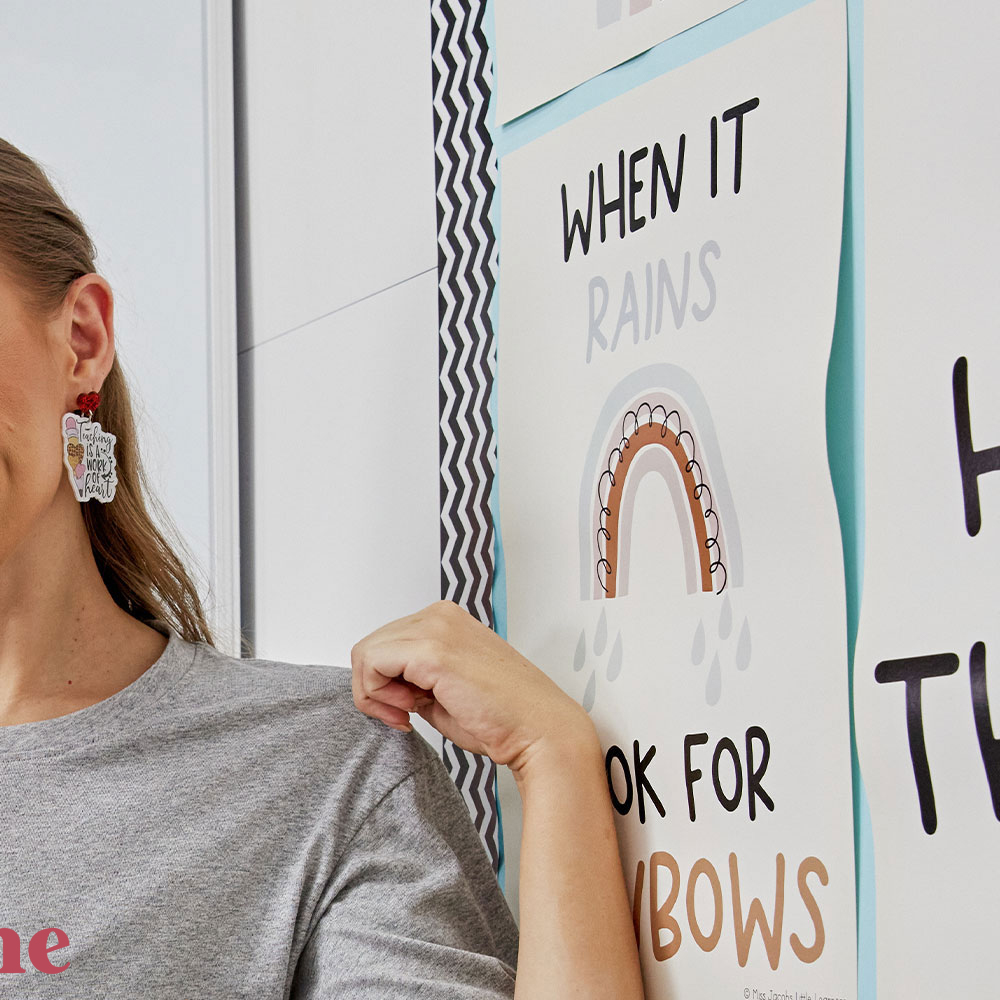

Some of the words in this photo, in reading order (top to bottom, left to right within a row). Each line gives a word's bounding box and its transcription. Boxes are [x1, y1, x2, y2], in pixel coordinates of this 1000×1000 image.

[562, 134, 685, 262] WHEN
[710, 97, 760, 198] IT
[586, 240, 721, 363] RAINS
[87, 458, 107, 472] WORK
[684, 726, 775, 822] FOR
